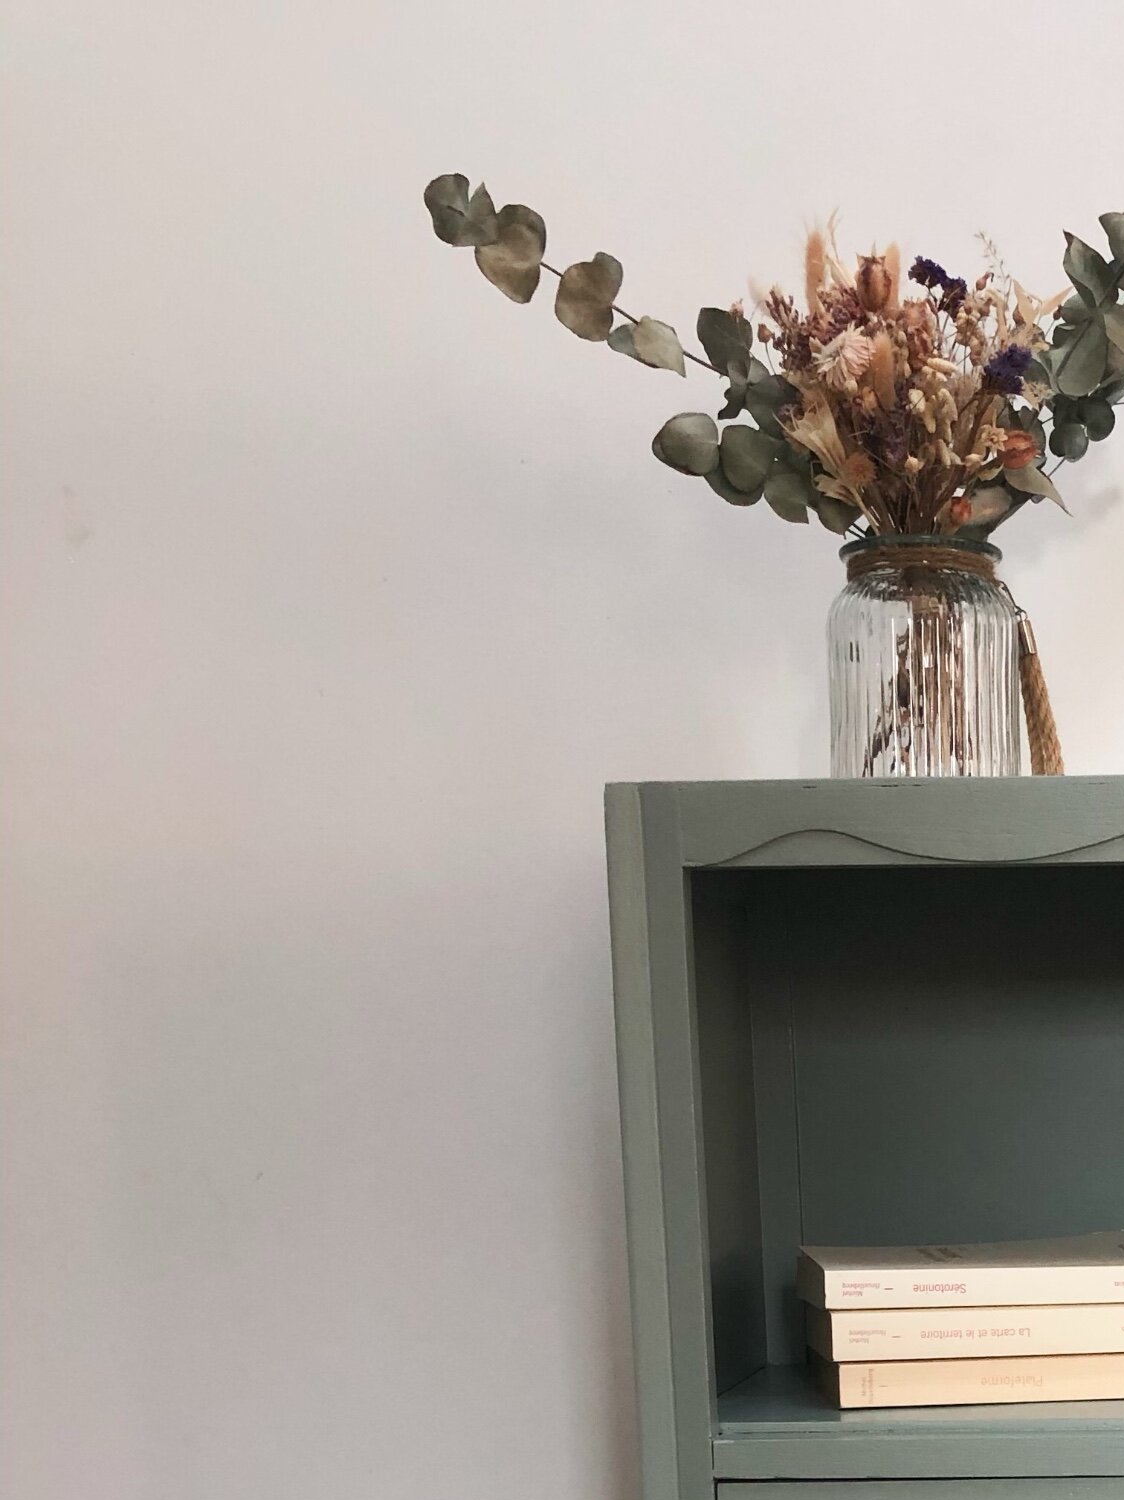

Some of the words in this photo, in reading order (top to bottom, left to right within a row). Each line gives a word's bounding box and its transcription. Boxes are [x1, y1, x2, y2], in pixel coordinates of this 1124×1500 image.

[912, 1283, 966, 1294] Sérotonine
[920, 1329, 963, 1340] territoire
[966, 1330, 974, 1340] le
[978, 1329, 988, 1338] et
[991, 1328, 1016, 1338] carte
[1018, 1328, 1030, 1338] La
